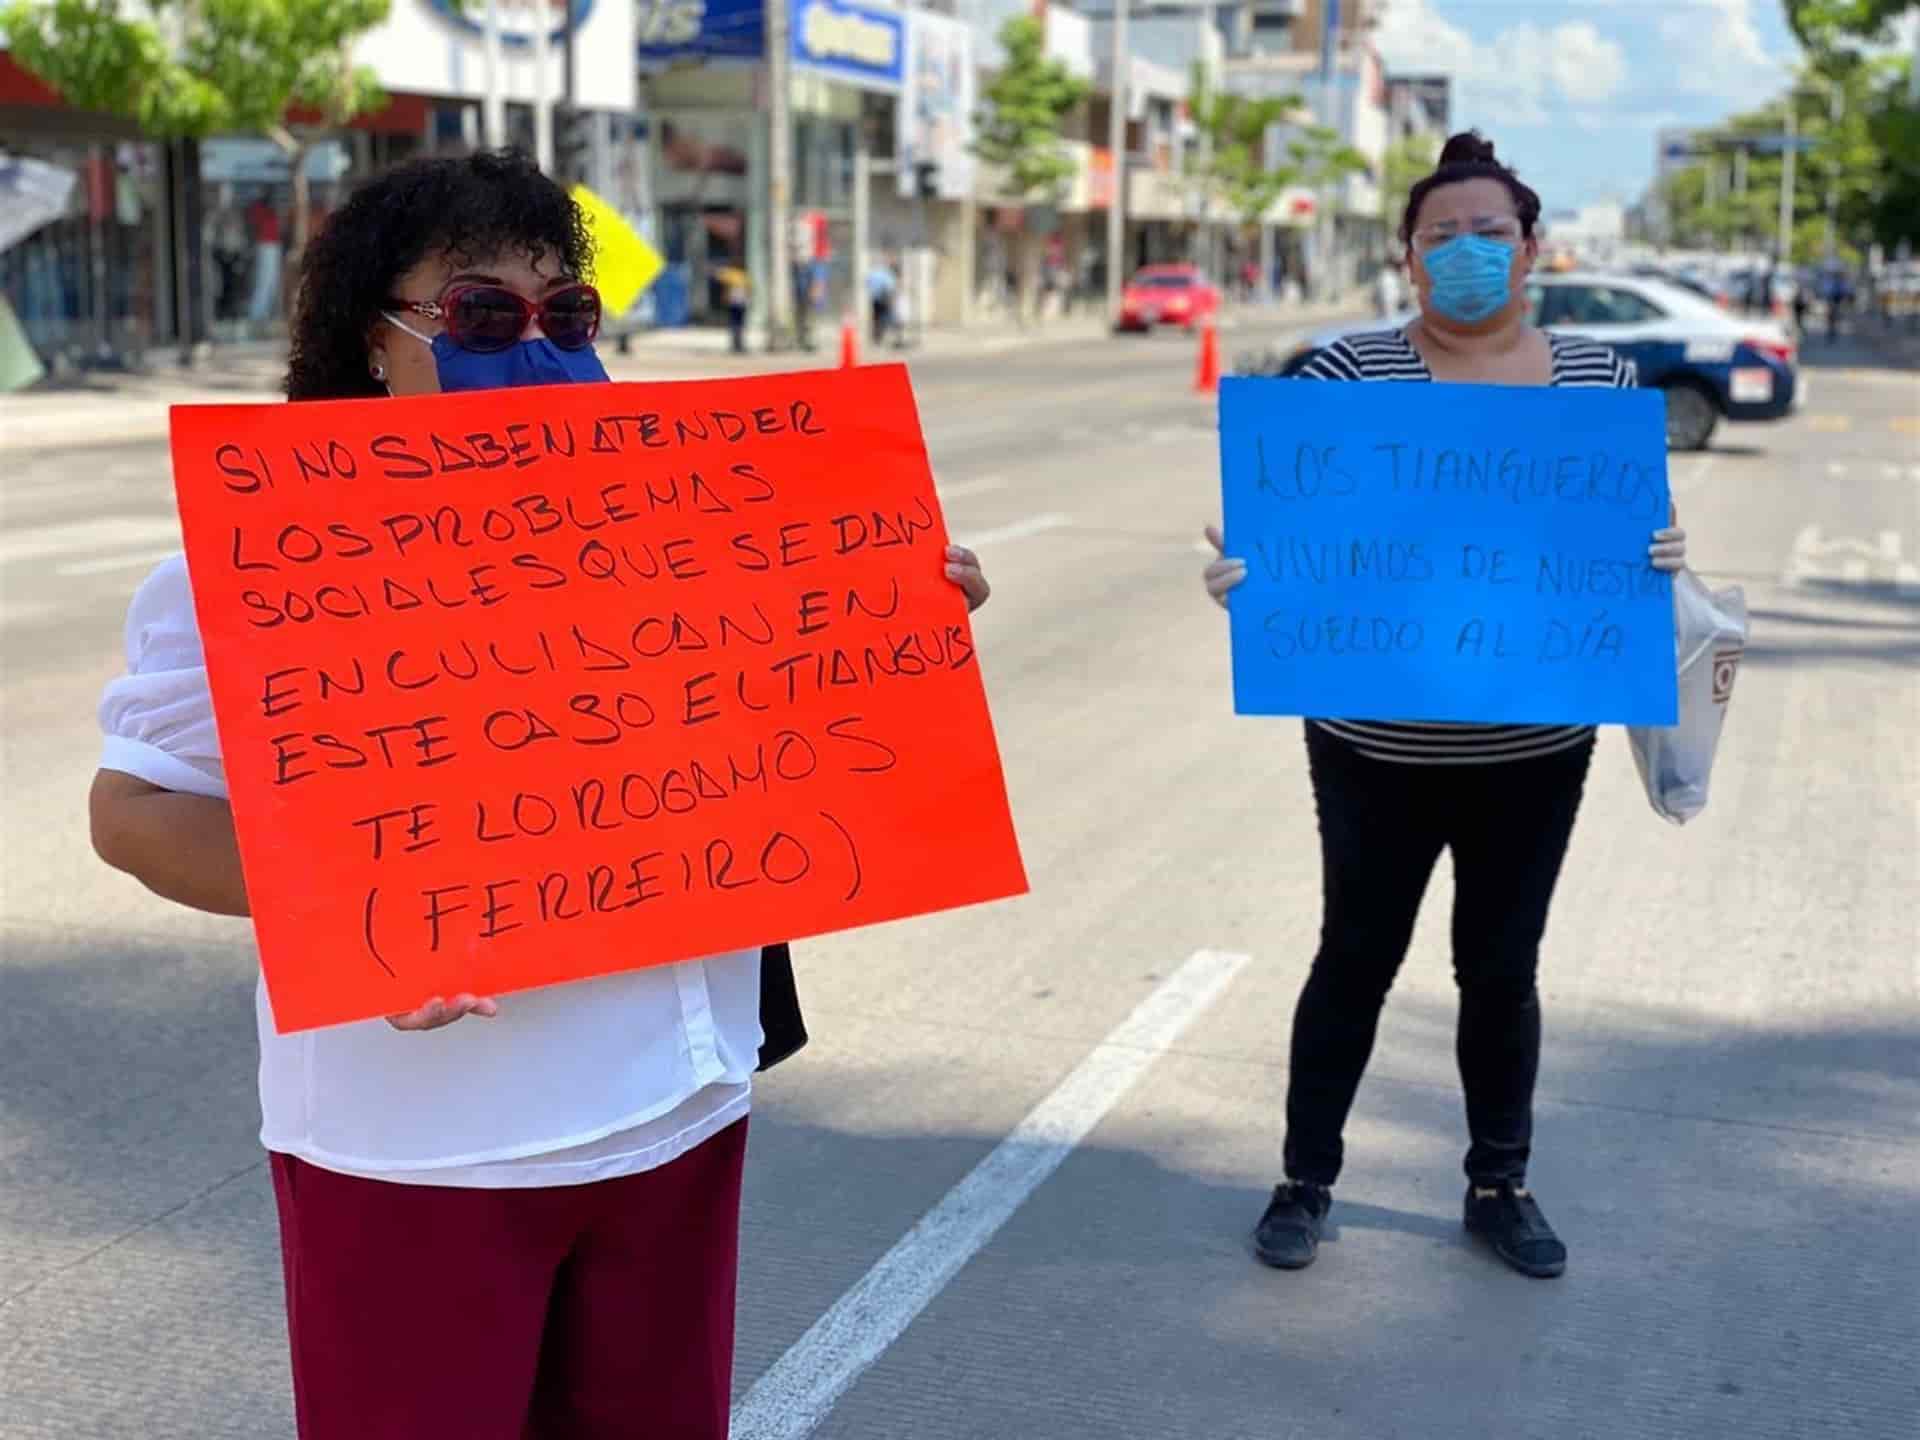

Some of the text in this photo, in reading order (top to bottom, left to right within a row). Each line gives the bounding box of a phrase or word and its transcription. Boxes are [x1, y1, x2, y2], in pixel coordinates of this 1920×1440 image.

[216, 400, 826, 494] SI NO SABEN ATENDER
[1255, 434, 1356, 501] LOS
[232, 464, 776, 571] LOS PROBLEMAS
[241, 496, 934, 628] SOCIALES QUE SE DAN
[1460, 543, 1519, 586] DE
[261, 656, 366, 717] EN
[796, 577, 899, 635] EN
[1264, 610, 1425, 661] SUELDO
[1456, 617, 1520, 658] AL
[270, 715, 457, 786] ESTE
[483, 692, 655, 750] CASO
[682, 671, 770, 726] EL
[352, 716, 897, 860] TE LO ROGAMOS
